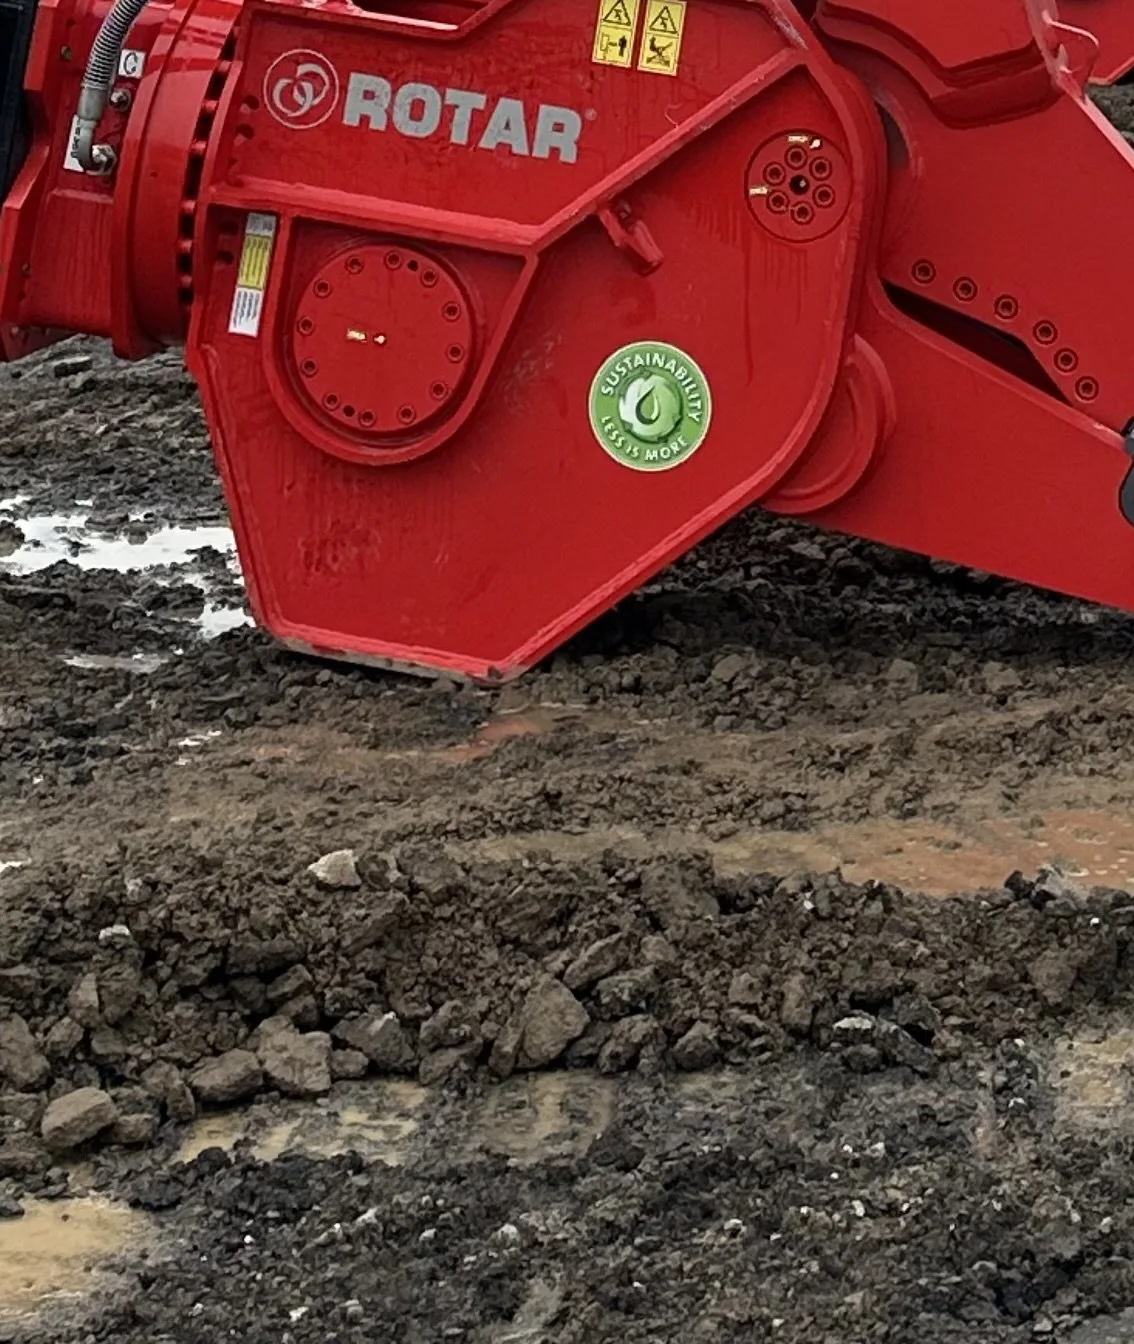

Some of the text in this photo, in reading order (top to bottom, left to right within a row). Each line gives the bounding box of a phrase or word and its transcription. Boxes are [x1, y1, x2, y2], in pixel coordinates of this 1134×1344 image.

[342, 71, 582, 164] ROTAR
[600, 352, 703, 423] SUSTAINABILITY
[600, 415, 688, 461] LESS IS MORE
